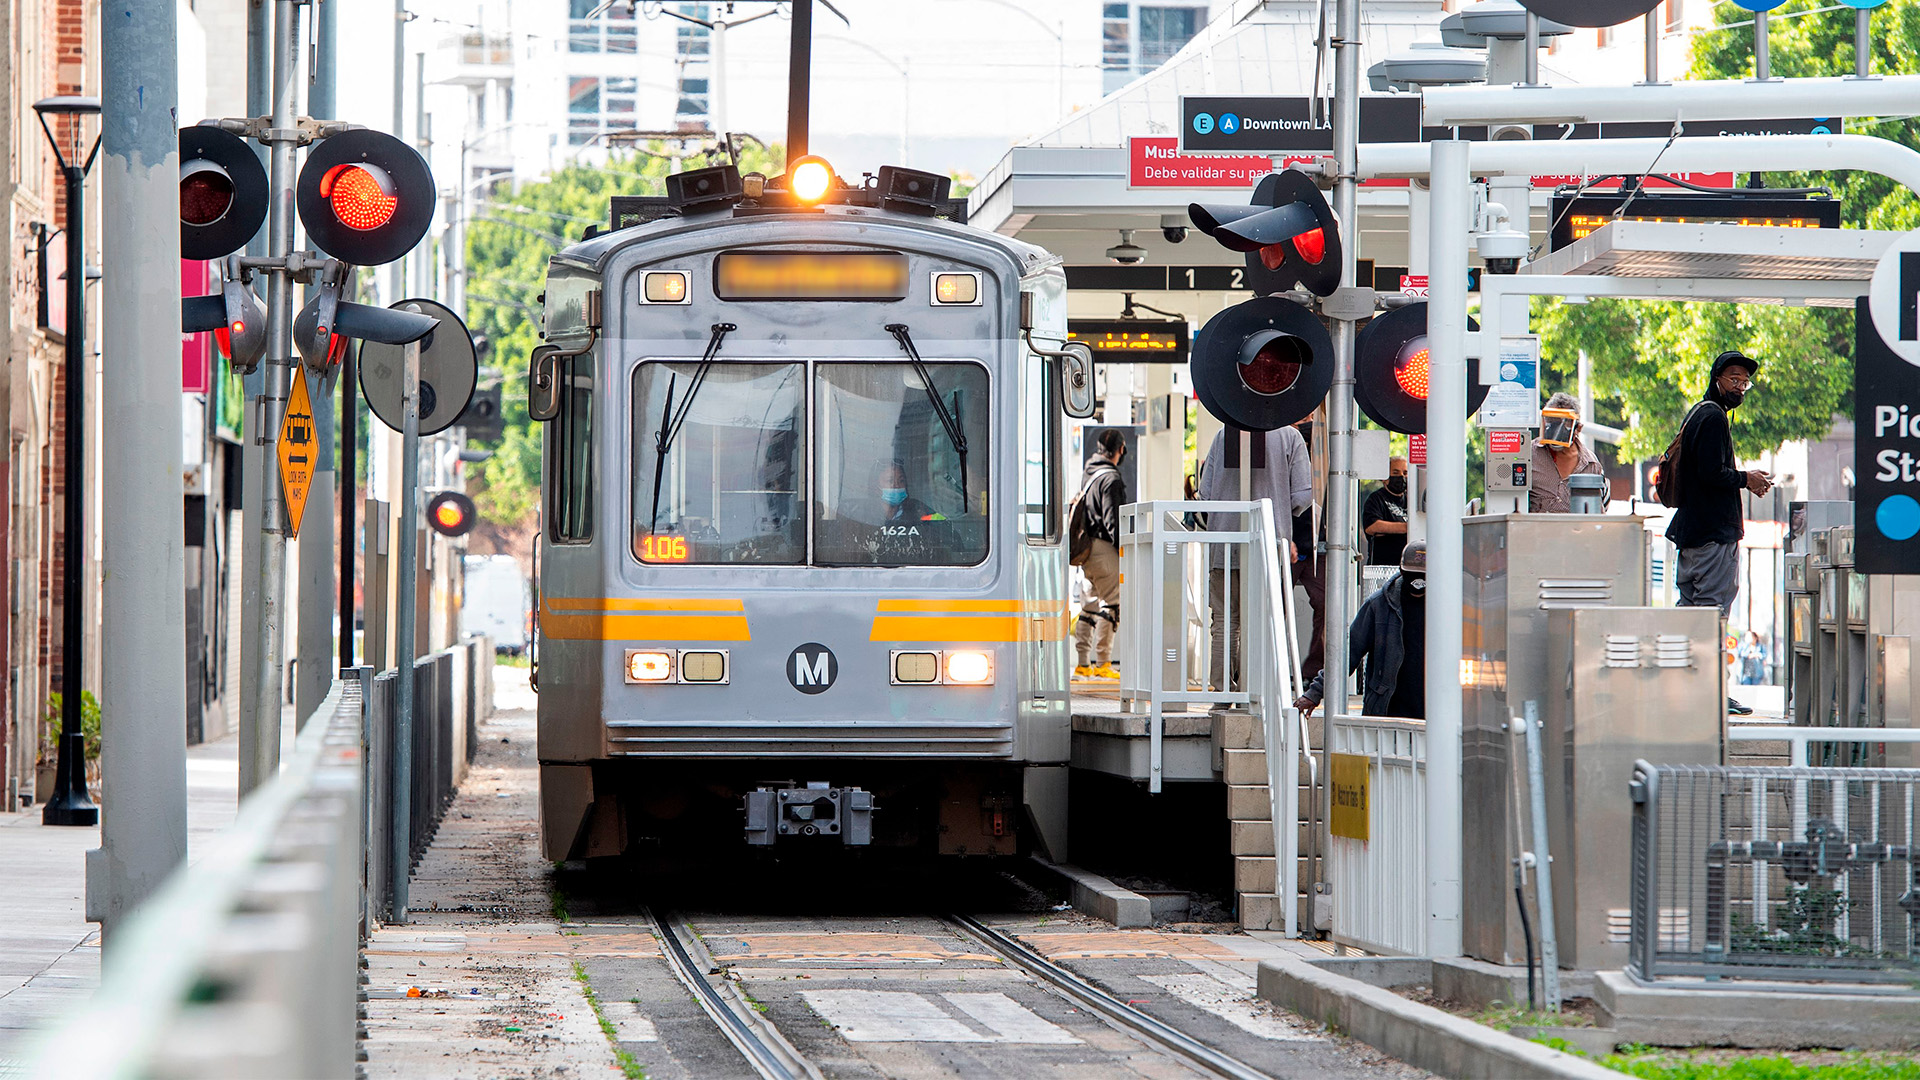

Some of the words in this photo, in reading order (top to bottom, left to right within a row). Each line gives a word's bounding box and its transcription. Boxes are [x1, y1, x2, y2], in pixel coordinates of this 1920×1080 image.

[1243, 118, 1310, 130] Downtown
[1314, 119, 1332, 130] LA
[1145, 146, 1181, 159] Must
[1145, 166, 1178, 179] Debe
[1181, 166, 1225, 179] validar
[1229, 169, 1244, 179] su
[1185, 268, 1195, 289] 1
[1230, 268, 1244, 289] 2
[880, 525, 919, 536] 162A
[644, 536, 686, 559] 106
[796, 652, 829, 686] M
